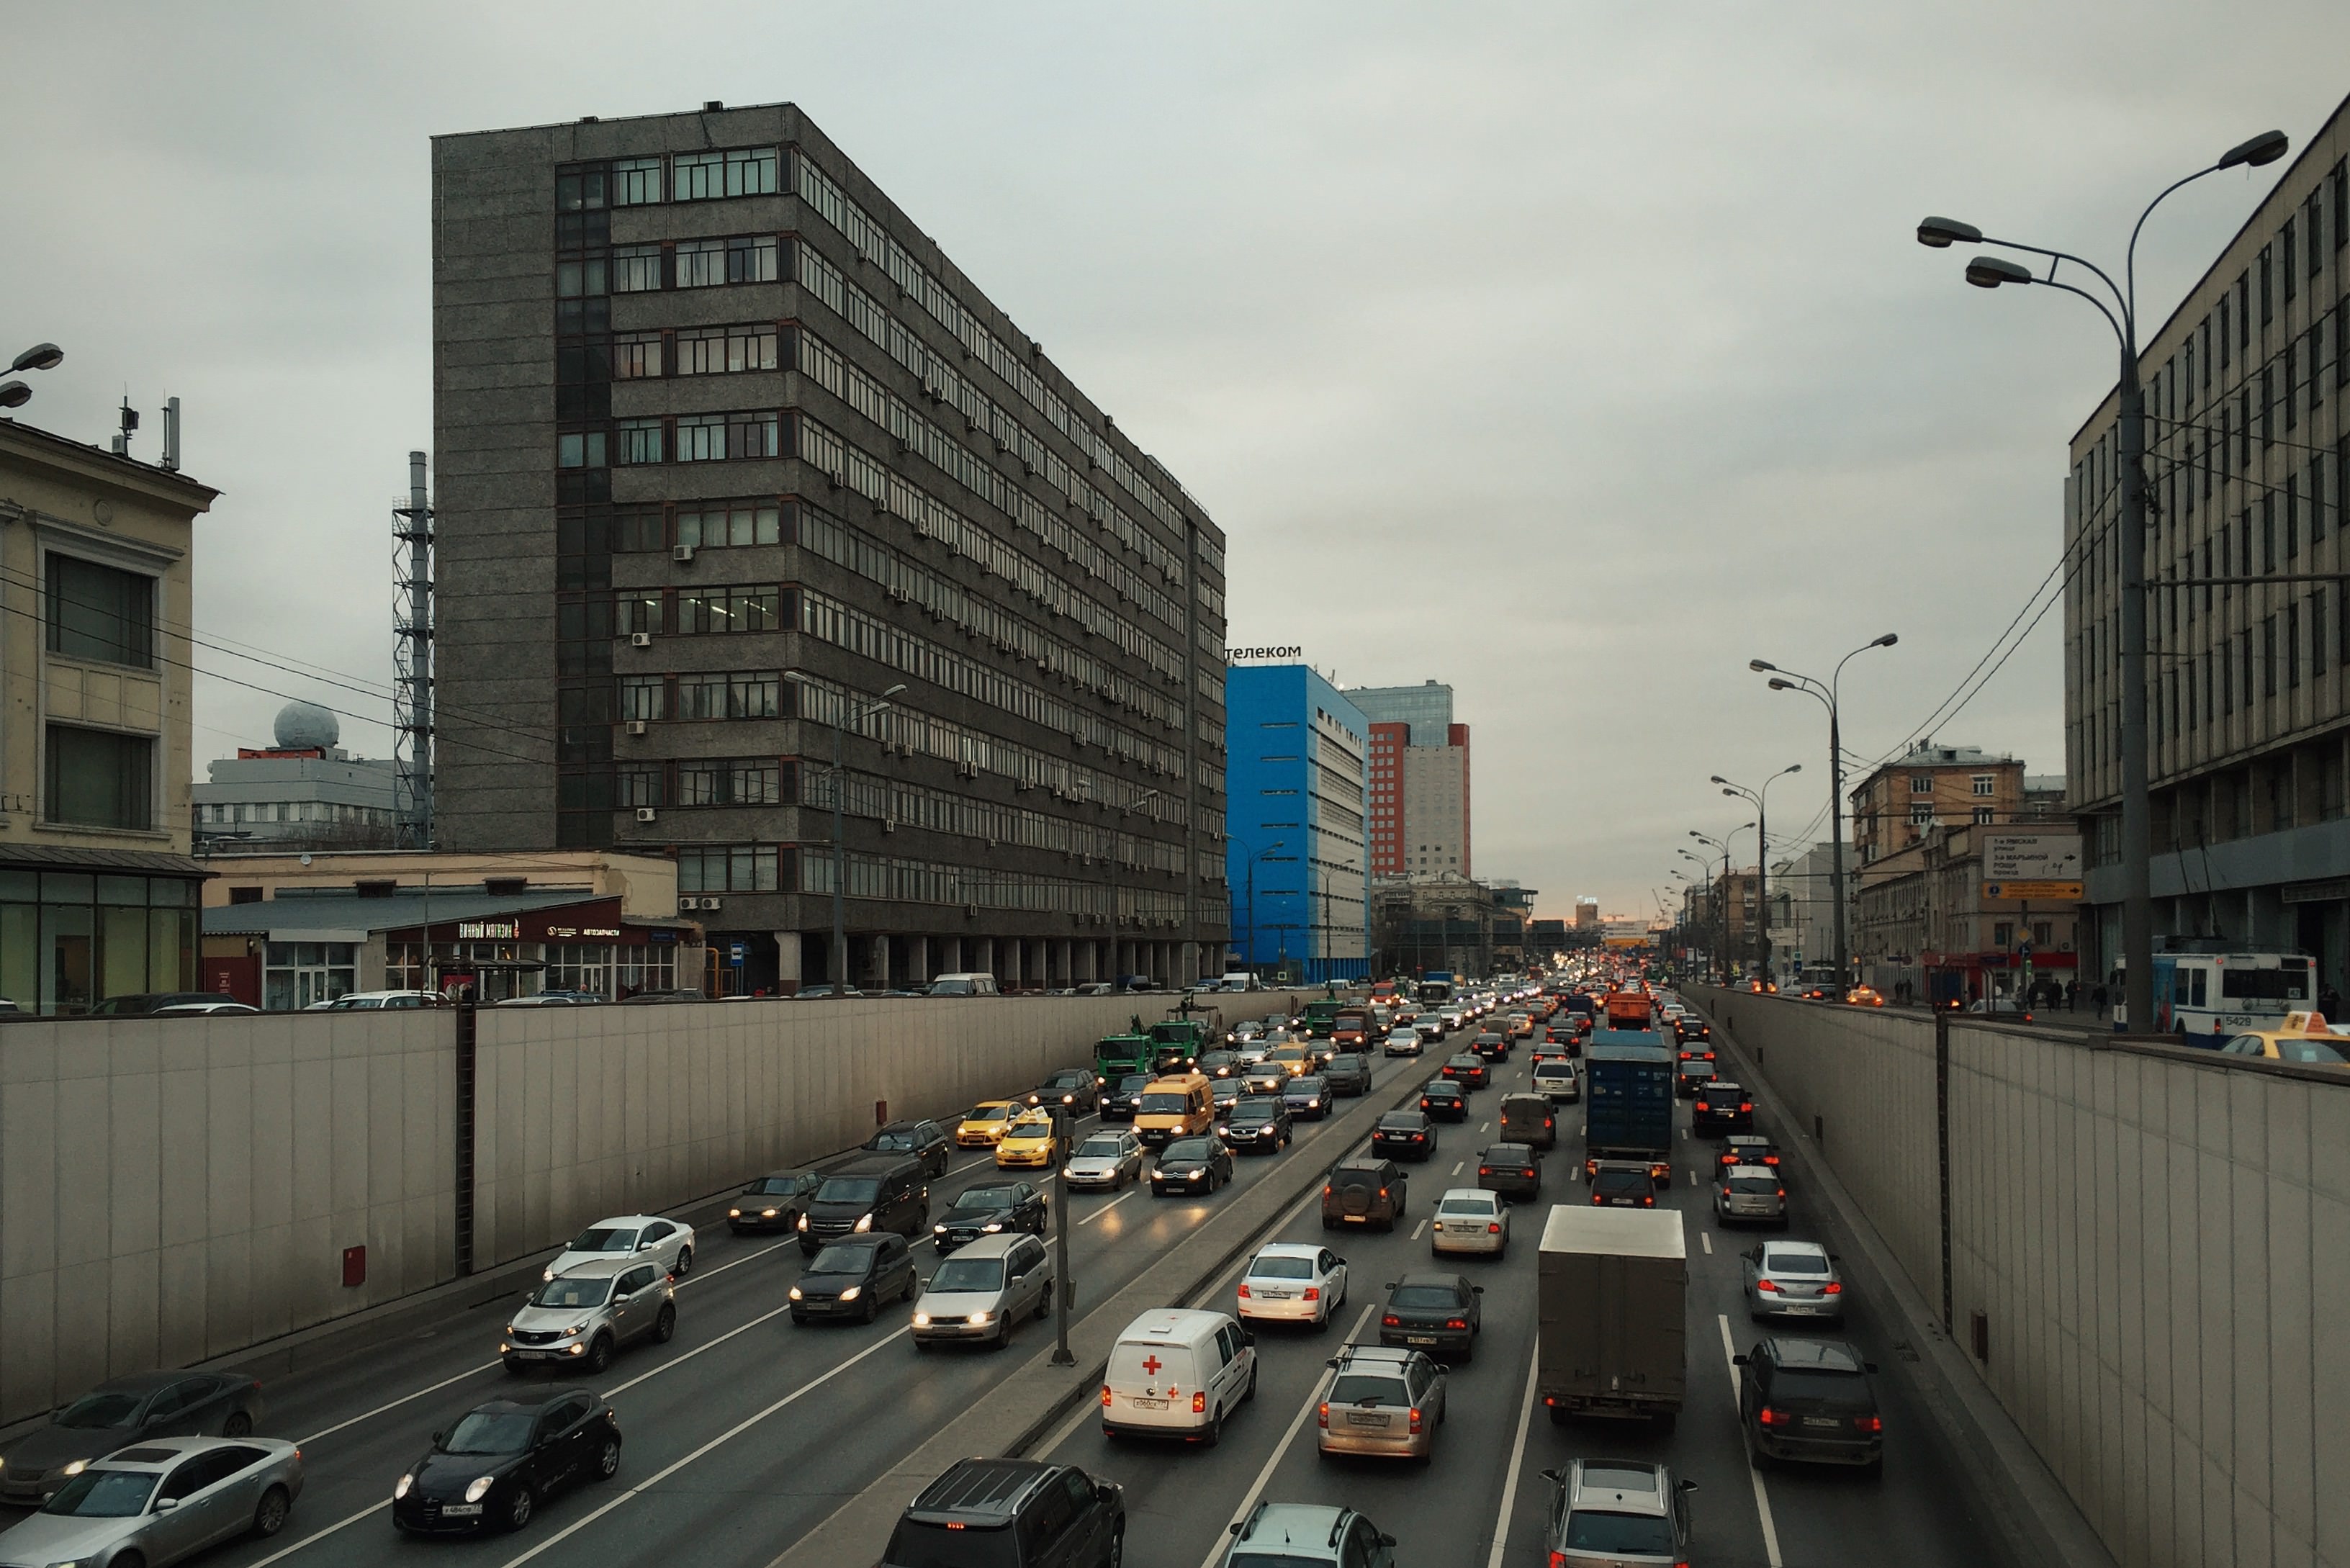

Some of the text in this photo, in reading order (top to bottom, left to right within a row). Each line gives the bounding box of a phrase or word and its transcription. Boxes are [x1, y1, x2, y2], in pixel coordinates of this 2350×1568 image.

[1225, 646, 1301, 659] телеком
[2006, 852, 2048, 861] МАРЬИНОЙ
[582, 928, 620, 937] АВТОЗАПЧАСТИ
